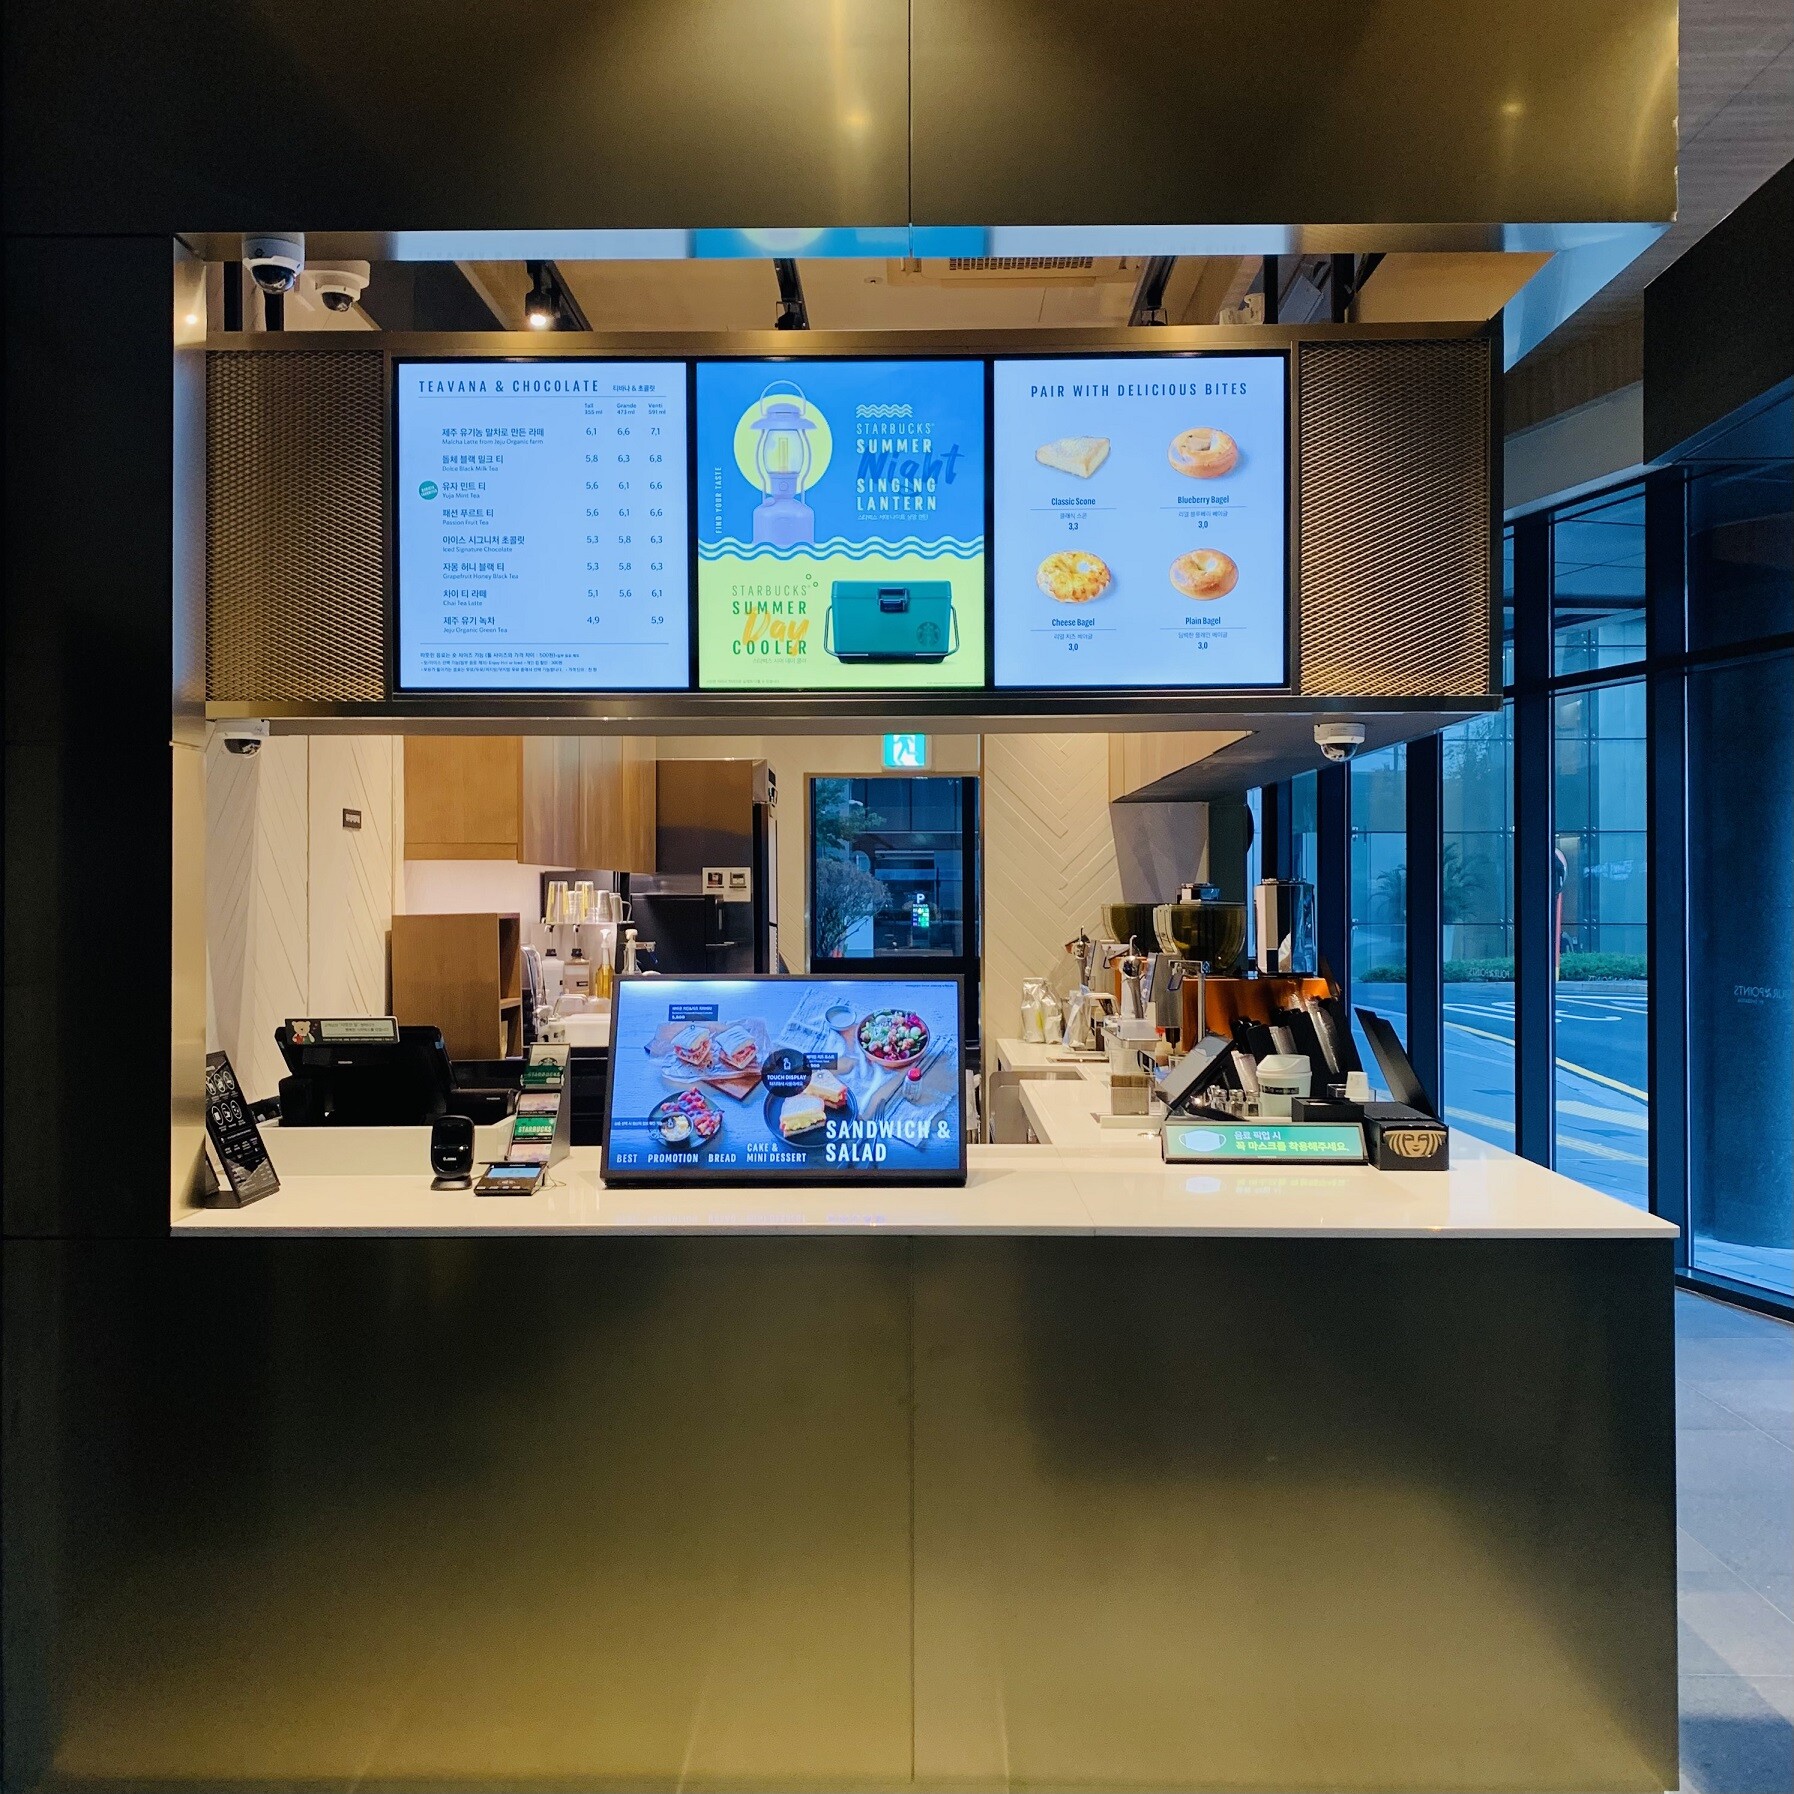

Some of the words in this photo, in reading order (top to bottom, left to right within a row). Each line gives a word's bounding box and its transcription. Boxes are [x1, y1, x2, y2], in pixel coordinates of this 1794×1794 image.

[419, 380, 487, 392] TEAVANA
[496, 381, 504, 392] &
[512, 380, 599, 392] CHOCOLATE
[1031, 385, 1065, 397] PAIR
[1073, 384, 1109, 397] WITH
[1118, 384, 1197, 396] DELICIOUS
[1205, 383, 1247, 395] BITES
[442, 428, 457, 437] 제주
[460, 428, 482, 437] 유기농
[511, 428, 526, 437] 만든
[529, 428, 544, 437] 라떼
[586, 428, 597, 437] 6,1
[617, 428, 630, 437] 6,6
[651, 428, 660, 437] 7,1
[856, 423, 931, 435] STARBUCKS
[856, 439, 932, 453] SUMMER
[460, 455, 475, 464] 블랙
[496, 455, 503, 464] 티
[585, 454, 598, 463] 5,8
[618, 454, 630, 463] 6,3
[649, 454, 662, 463] 6,8
[442, 482, 457, 491] 유자
[461, 482, 475, 491] 민트
[478, 482, 486, 490] 티
[586, 482, 598, 490] 5,6
[618, 482, 630, 490] 6,1
[650, 482, 662, 490] 6,6
[857, 478, 936, 493] SINGING
[857, 496, 936, 511] LANTERN
[1051, 497, 1074, 506] Classic
[1076, 497, 1096, 505] Scone
[1178, 496, 1209, 504] Blueberry
[1211, 496, 1229, 504] Bagel
[486, 509, 494, 517] 티
[586, 508, 599, 517] 5,6
[619, 508, 630, 517] 6,1
[650, 508, 663, 517] 6,6
[1068, 522, 1079, 530] 3,3
[443, 536, 466, 544] 아이스
[469, 536, 500, 544] 시그니처
[586, 536, 598, 544] 5,3
[619, 536, 631, 544] 5,8
[651, 536, 662, 544] 6,3
[497, 563, 504, 571] 티
[587, 562, 599, 571] 5,3
[619, 562, 631, 571] 5,8
[651, 562, 663, 571] 6,3
[444, 590, 458, 598] 차이
[462, 590, 468, 598] 티
[472, 590, 486, 598] 라떼
[588, 589, 598, 598] 5,1
[619, 589, 632, 598] 5,6
[651, 589, 662, 598] 6,1
[732, 585, 807, 596] STARBUCKS
[732, 601, 807, 615] SUMMER
[444, 617, 459, 625] 제주
[462, 617, 476, 625] 유기
[480, 617, 494, 625] 녹차
[587, 616, 600, 625] 4,9
[651, 616, 663, 625] 5,9
[1052, 618, 1075, 627] Cheese
[1077, 618, 1095, 627] Bagel
[1203, 617, 1221, 625] Bagel
[742, 607, 810, 656] Day
[732, 640, 807, 655] COOLER
[1068, 643, 1078, 651] 3,0
[1198, 641, 1208, 650] 3,0
[917, 893, 925, 903] P
[826, 1120, 931, 1138] SANDWICH
[938, 1121, 950, 1138] &
[1273, 1131, 1281, 1140] 시
[747, 1143, 769, 1152] CAKE
[772, 1143, 778, 1152] &
[1248, 1141, 1286, 1151] 마스크를
[826, 1143, 886, 1162] SALAD
[617, 1154, 637, 1162] BEST
[648, 1154, 698, 1162] PROMOTION
[708, 1154, 736, 1162] BREAD
[747, 1153, 767, 1162] MINI
[770, 1153, 806, 1162] DESSERT
